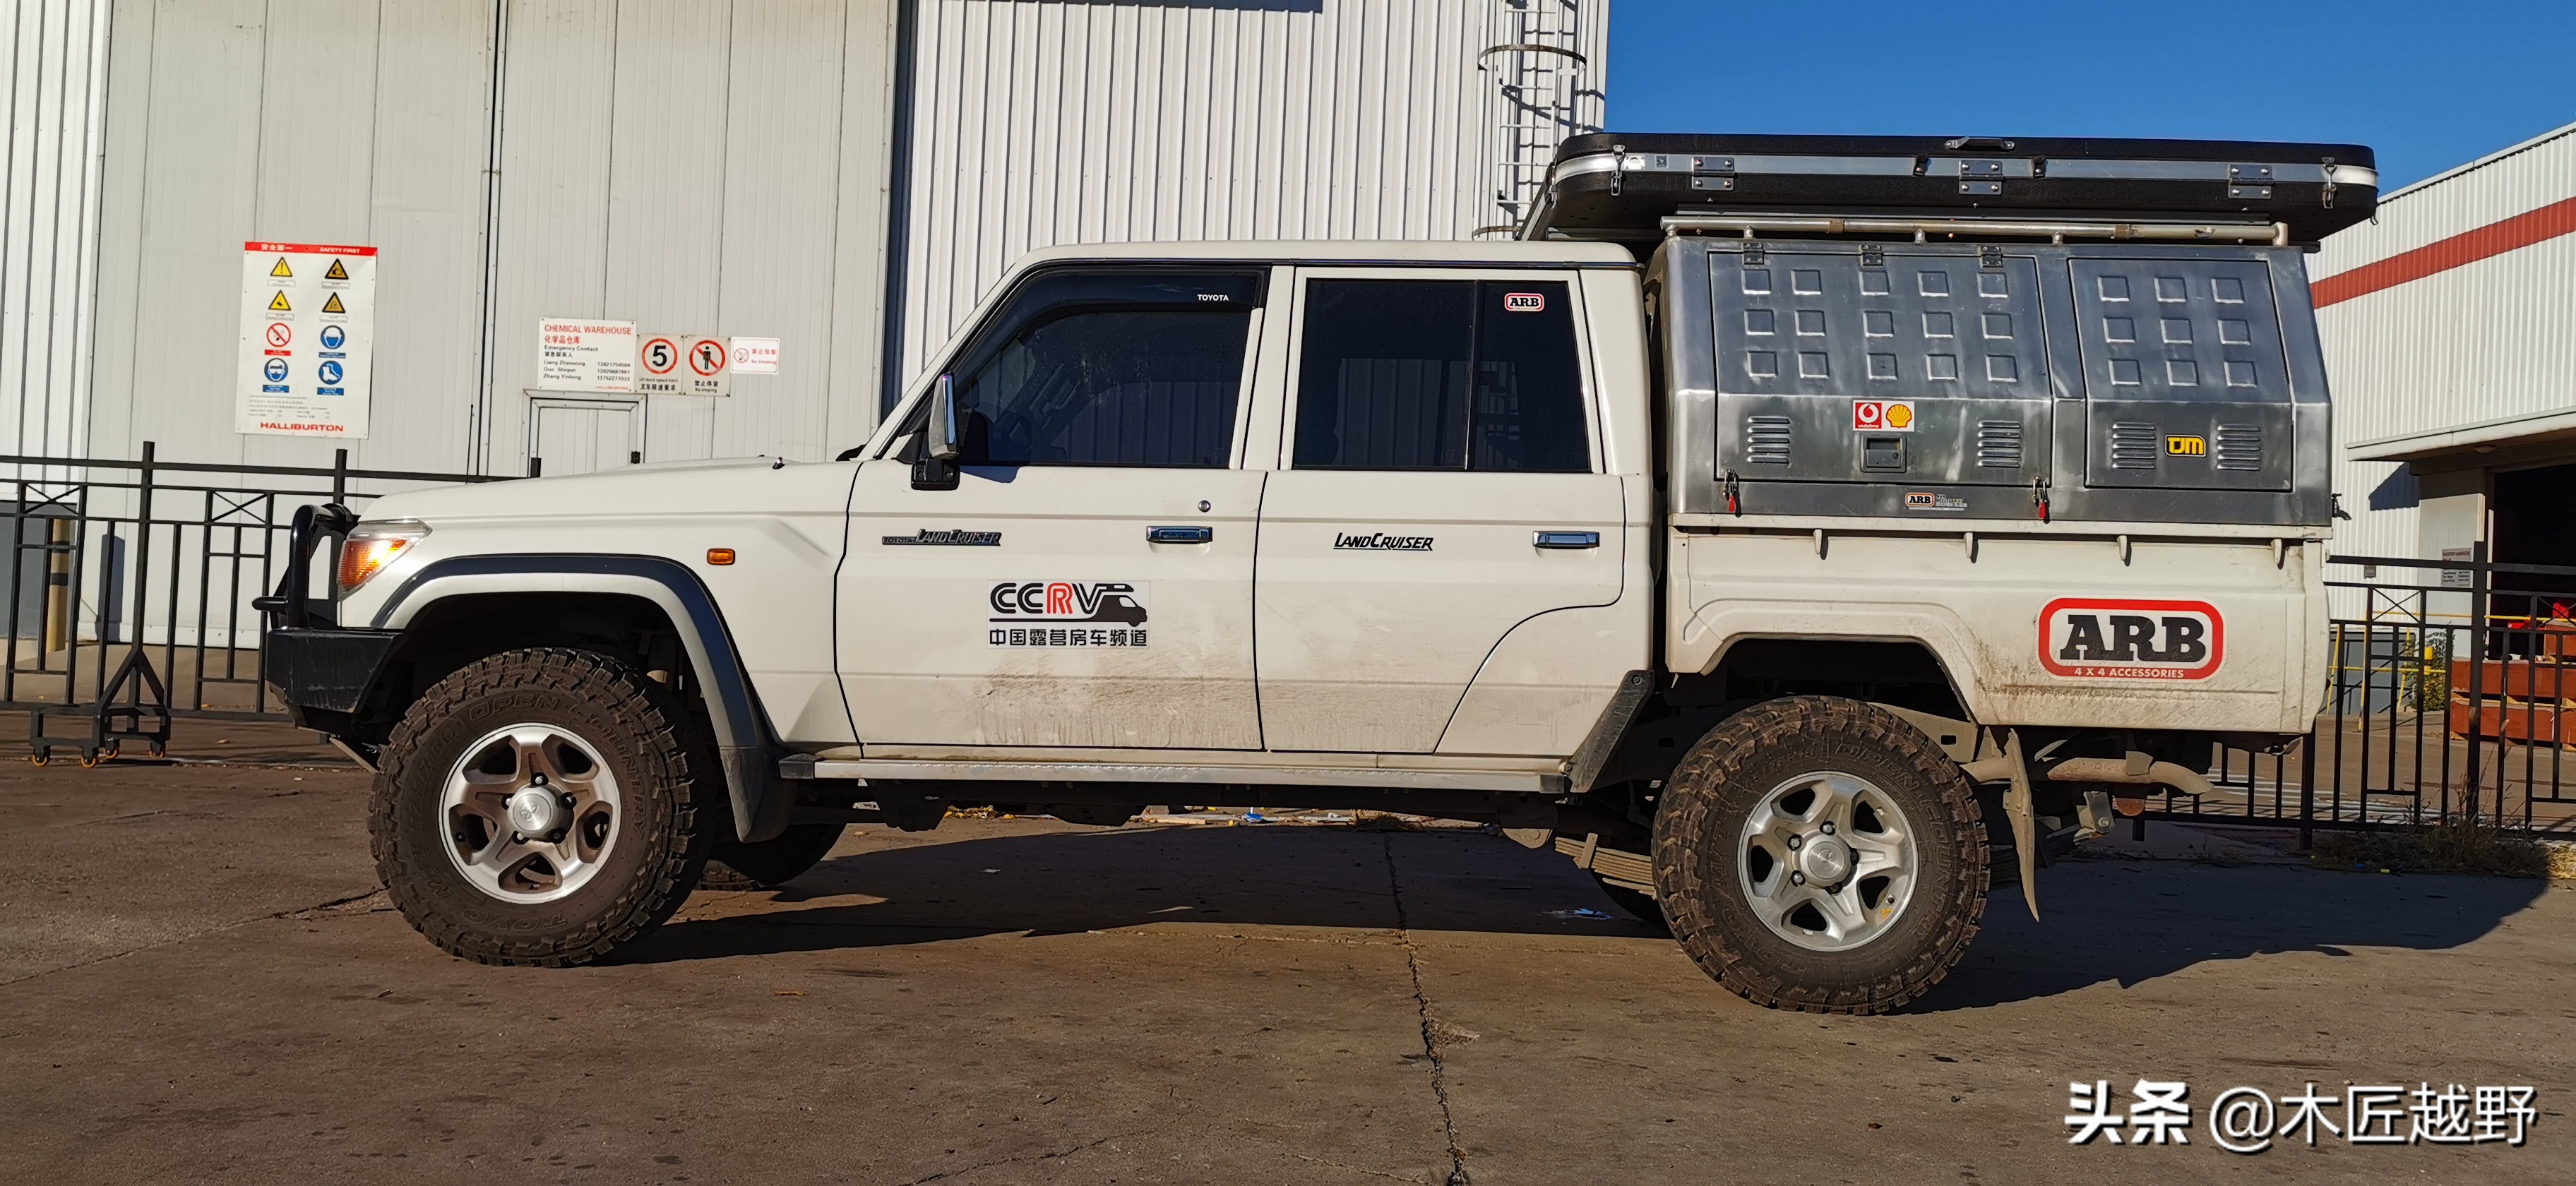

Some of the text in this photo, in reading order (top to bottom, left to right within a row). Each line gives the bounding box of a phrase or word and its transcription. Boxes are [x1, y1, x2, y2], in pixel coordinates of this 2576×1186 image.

[1510, 297, 1539, 307] ARB
[544, 324, 632, 335] CHEMICAL WAREHOUSE
[544, 335, 580, 345] 化学品仓库
[652, 345, 667, 367] 5
[260, 422, 344, 432] HALLIBURTON
[1909, 496, 1931, 504] ARB
[990, 582, 1107, 614] CCRV
[989, 628, 1147, 647] 中国露营房车频道
[2060, 613, 2206, 662] ARB
[2074, 667, 2082, 676] 4
[2097, 668, 2106, 677] 4
[2109, 669, 2185, 678] ACCESSORIES
[469, 693, 648, 840] OPEN COUNTRY
[1835, 743, 1952, 940] OPEN COUNTRY
[460, 908, 568, 933] TOYO
